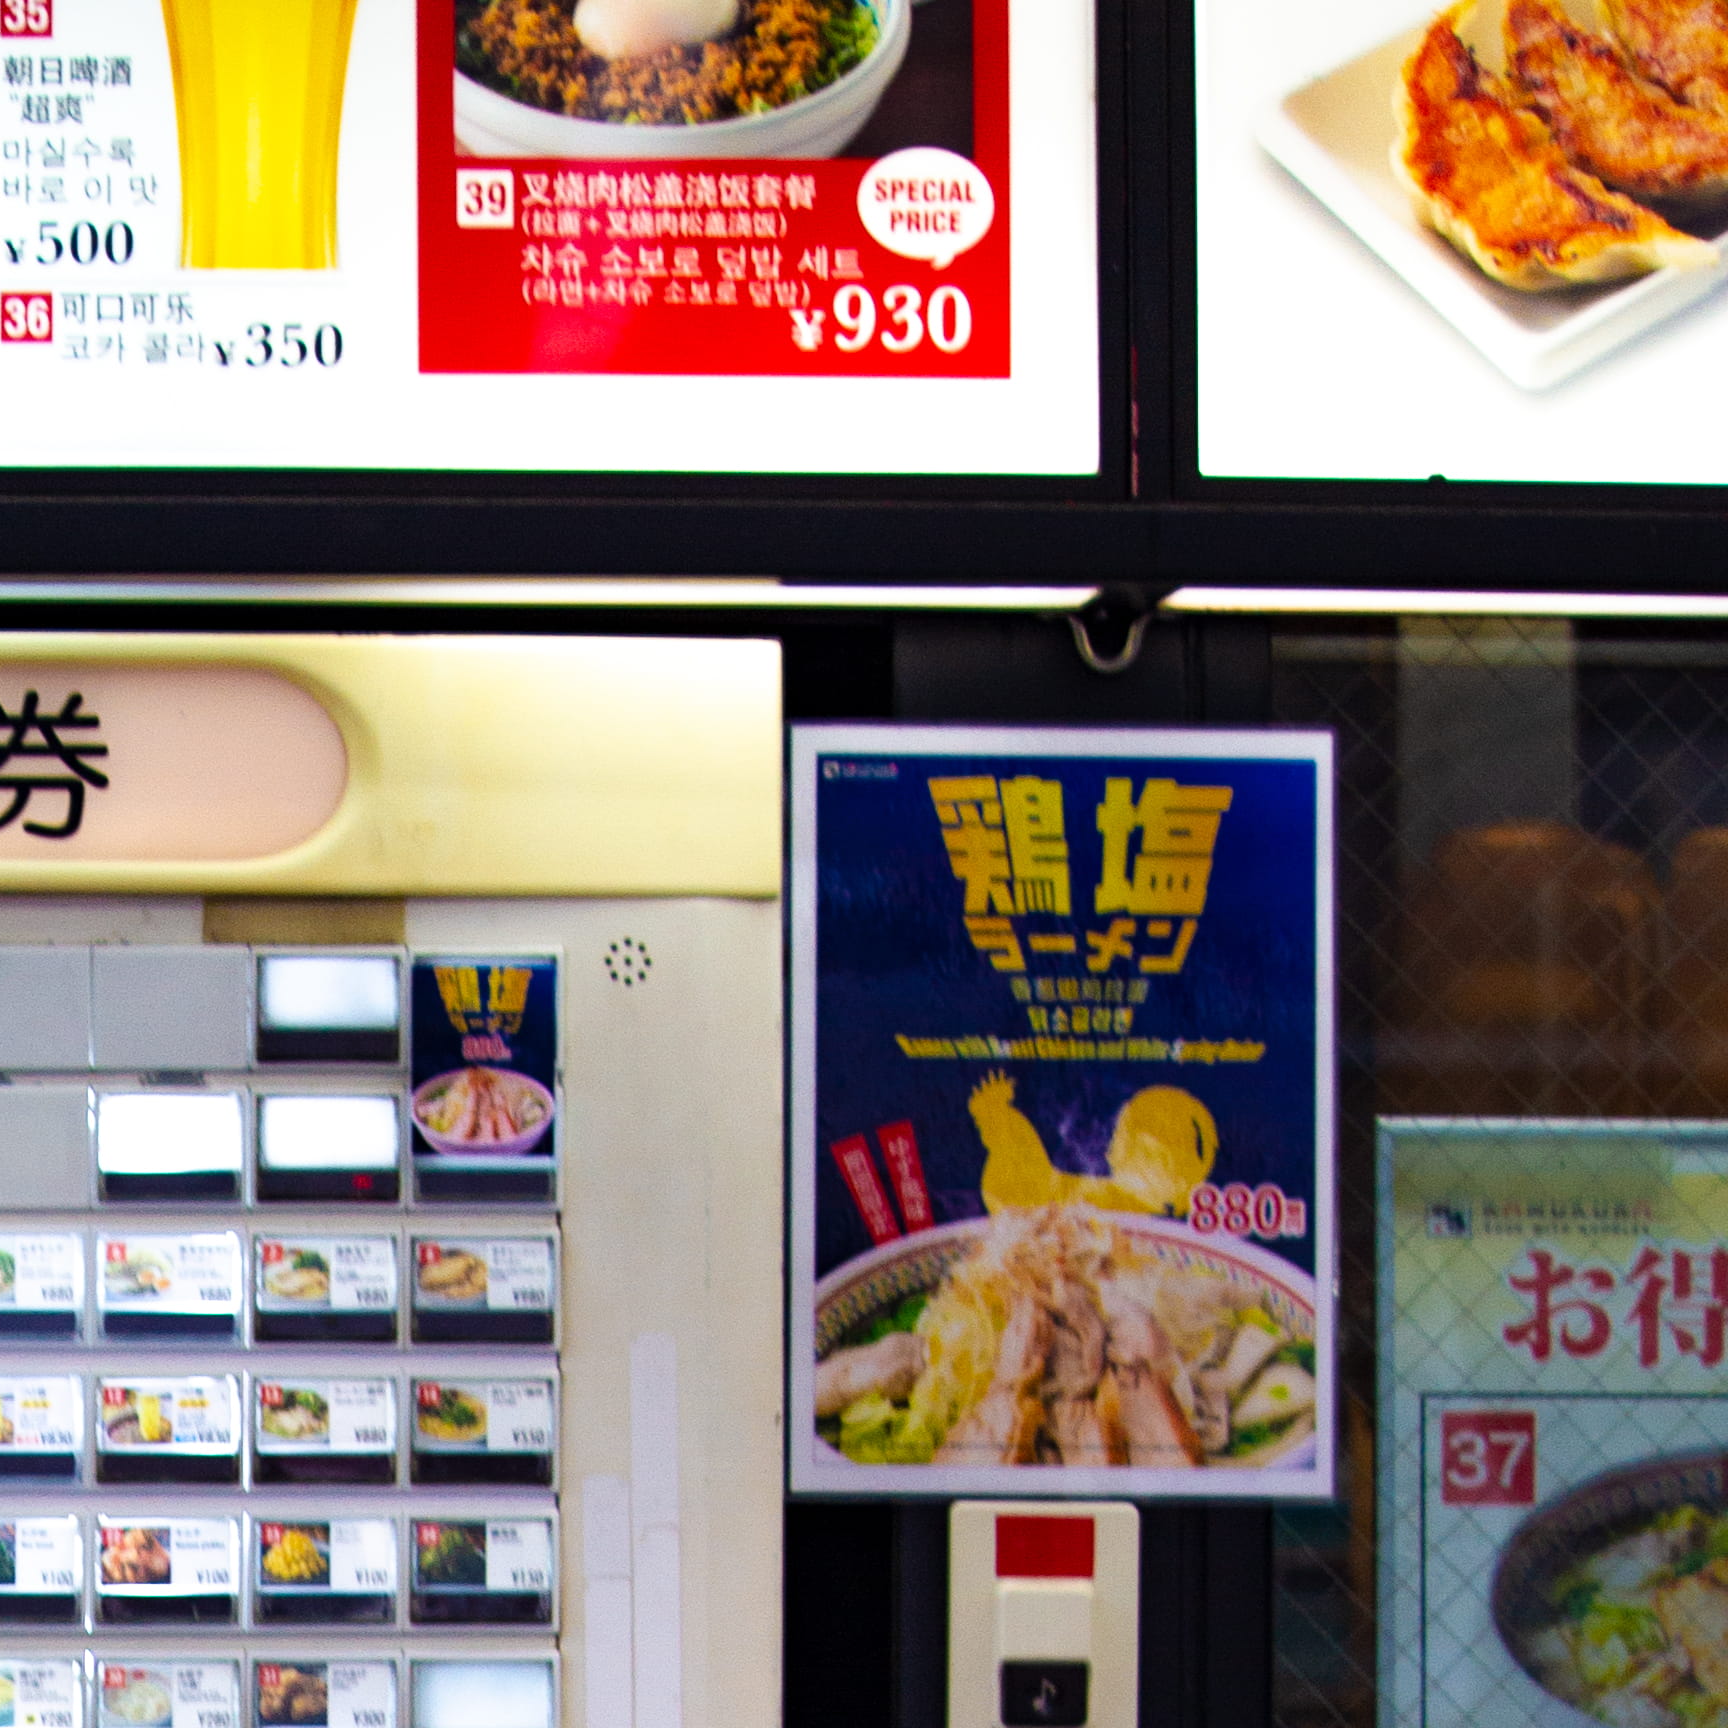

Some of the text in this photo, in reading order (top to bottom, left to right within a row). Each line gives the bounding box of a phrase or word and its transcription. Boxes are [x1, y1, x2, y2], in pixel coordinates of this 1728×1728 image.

[3, 0, 49, 32] 35
[3, 54, 133, 88] 朝日啤酒
[2, 174, 68, 204] 바로
[463, 180, 507, 216] 39
[874, 178, 976, 204] SPECIAL
[889, 210, 963, 235] PRICE
[5, 221, 134, 267] ¥500
[797, 244, 864, 281] 세트
[3, 298, 50, 338] 36
[61, 292, 194, 324] 可口可乐
[791, 283, 973, 355] ¥930
[212, 322, 344, 368] ¥350
[927, 776, 1234, 917] 鶏塩
[963, 916, 1198, 975] ラーメン
[1502, 1246, 1728, 1369] お得
[1449, 1431, 1529, 1489] 37
